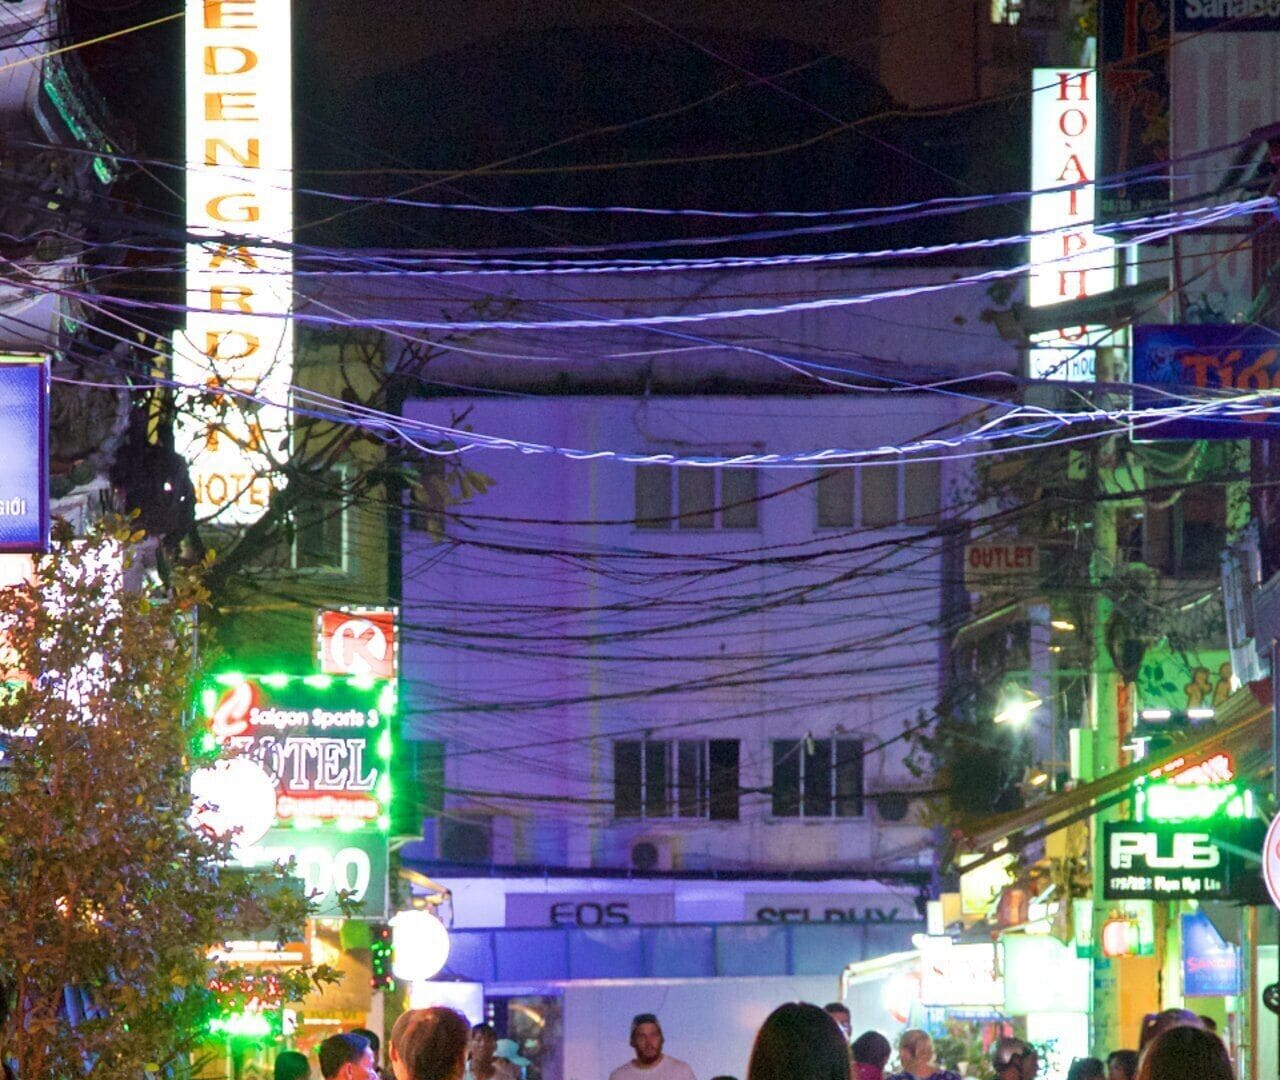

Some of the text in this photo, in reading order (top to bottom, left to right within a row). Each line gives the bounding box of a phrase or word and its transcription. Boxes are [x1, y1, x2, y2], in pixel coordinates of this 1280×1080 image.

[968, 547, 1037, 569] OUTLET
[249, 707, 310, 729] Saigon
[1110, 831, 1220, 870] PUB
[549, 901, 630, 927] EOS
